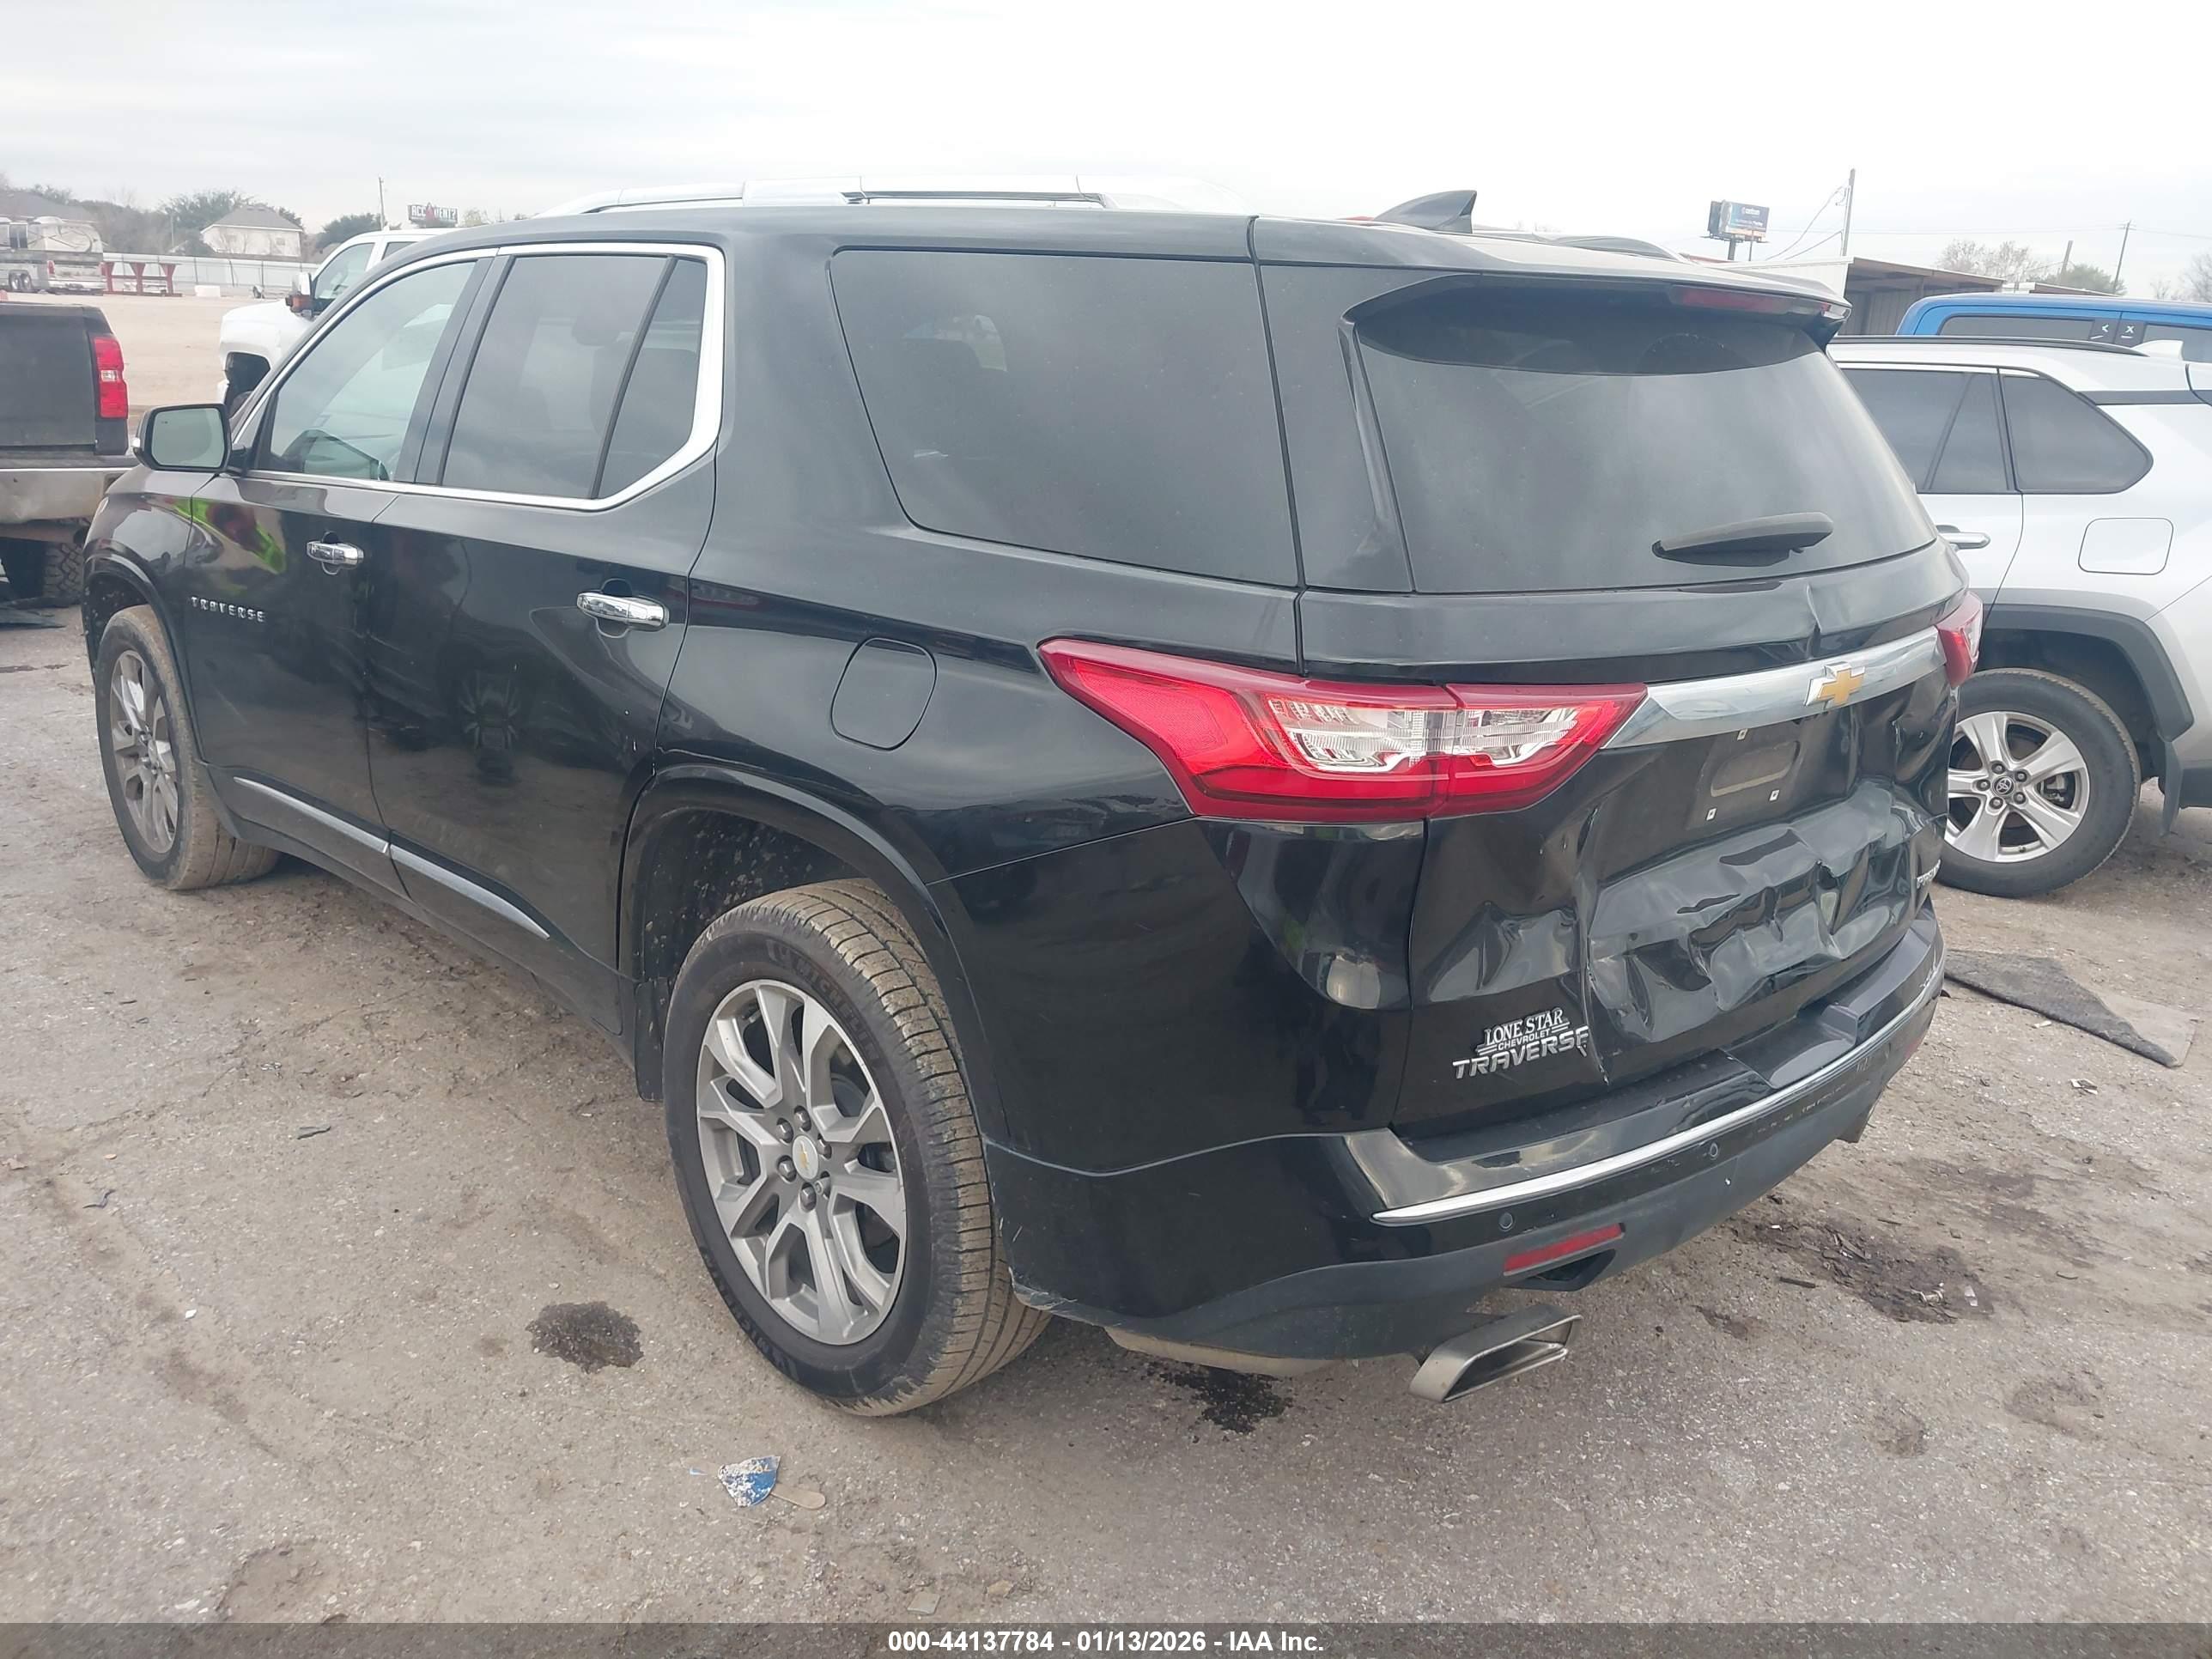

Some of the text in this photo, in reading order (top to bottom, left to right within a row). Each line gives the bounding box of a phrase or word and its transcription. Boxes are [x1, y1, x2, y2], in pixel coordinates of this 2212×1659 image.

[411, 205, 456, 220] ACCDENT?
[191, 596, 265, 623] TRAVERSE
[1485, 1008, 1564, 1046] LONE STAR
[1498, 1028, 1551, 1051] CHEVROLET
[1452, 1025, 1589, 1079] TRAVERSE
